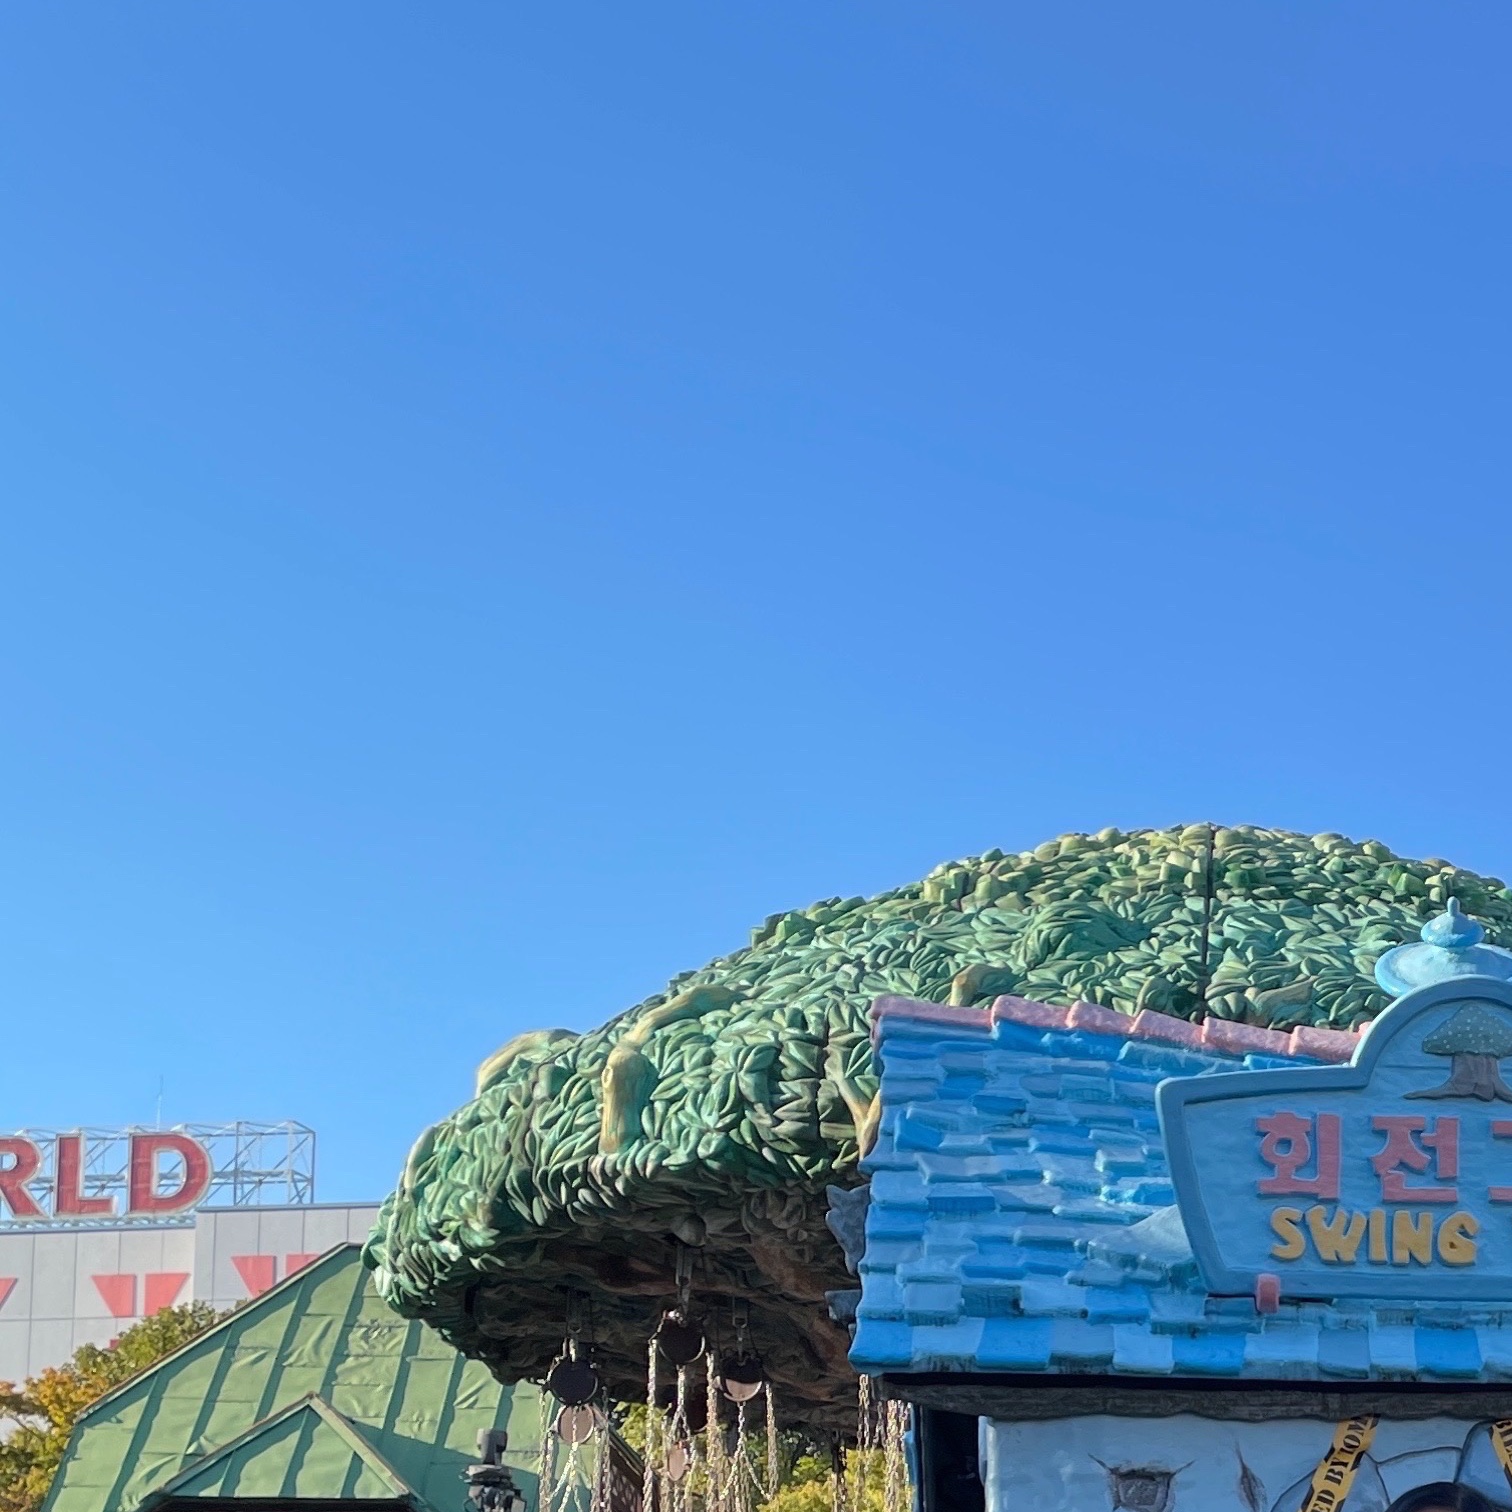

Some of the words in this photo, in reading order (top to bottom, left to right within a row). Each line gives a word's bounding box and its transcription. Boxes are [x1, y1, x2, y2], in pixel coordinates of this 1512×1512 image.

[0, 1131, 213, 1219] RLD
[1268, 1204, 1480, 1267] SWING
[1324, 1448, 1351, 1486] BY
